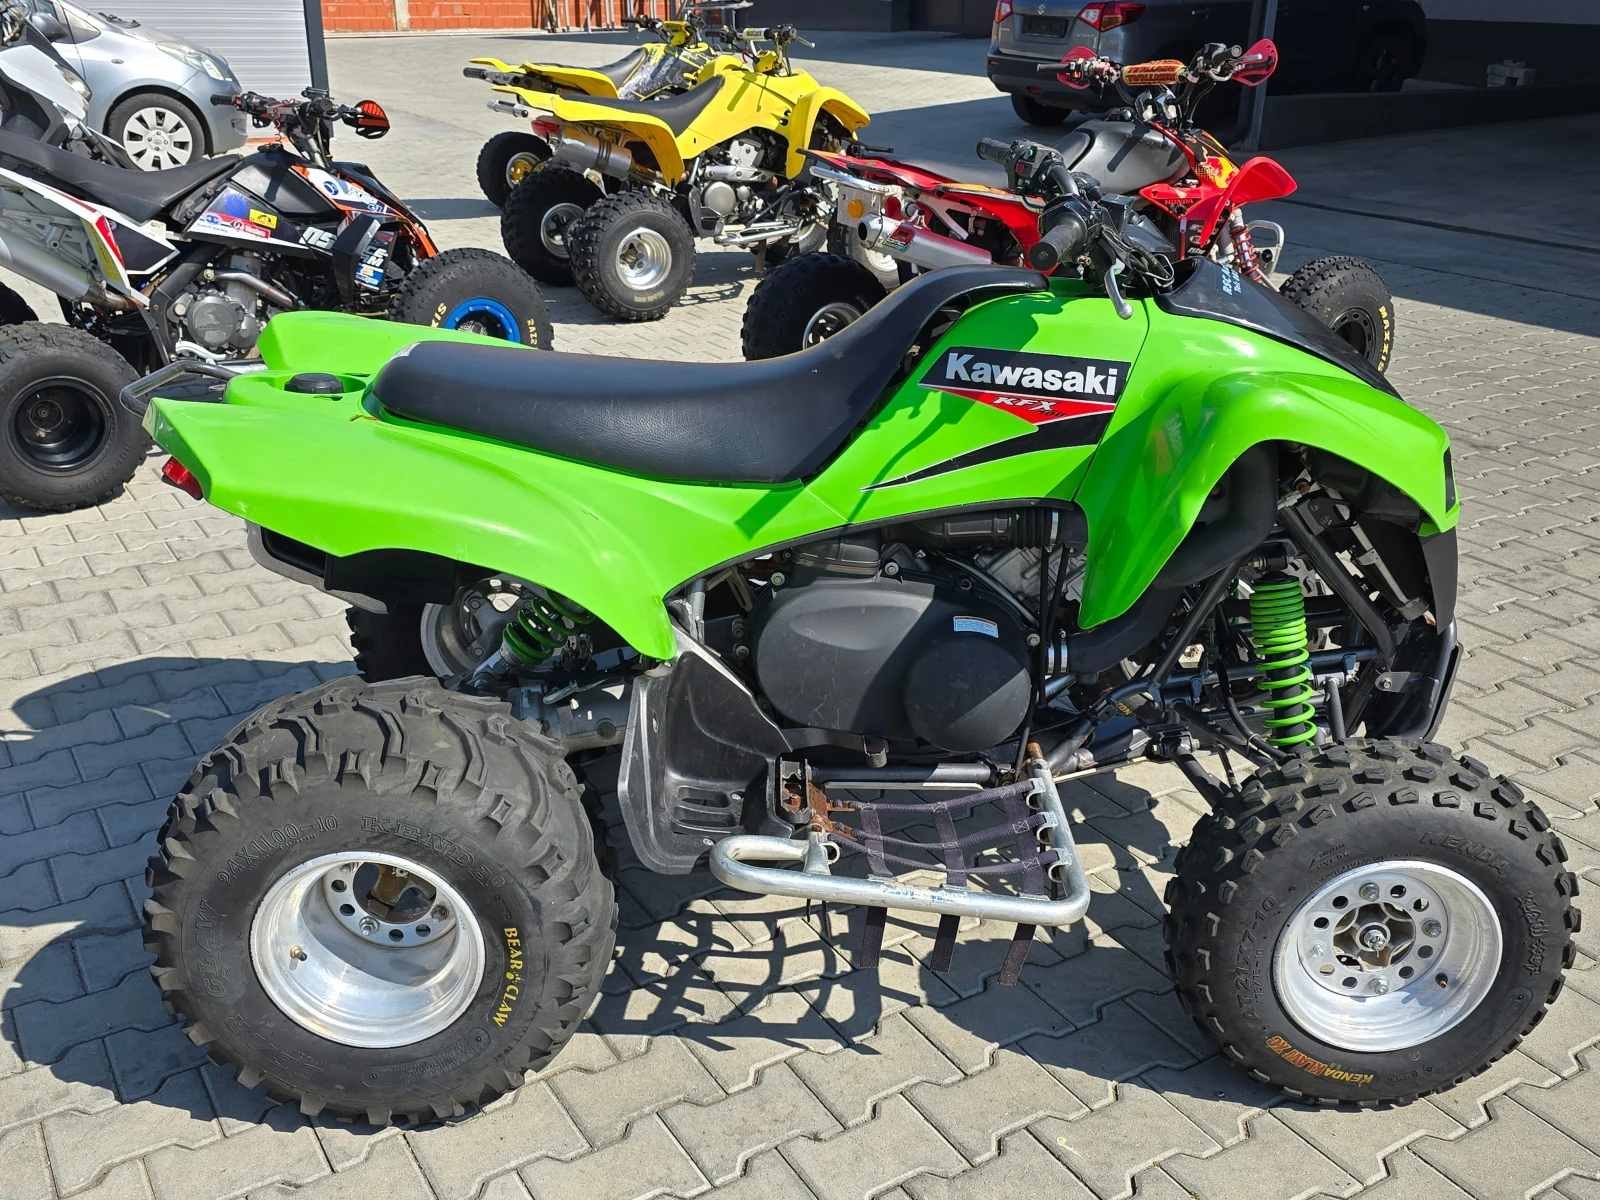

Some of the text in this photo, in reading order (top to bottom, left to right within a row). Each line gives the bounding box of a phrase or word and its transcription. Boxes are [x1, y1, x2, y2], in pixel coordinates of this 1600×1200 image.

[1222, 274, 1233, 296] RSC
[526, 318, 538, 346] RAZR
[1378, 305, 1391, 372] MAXXIS
[945, 352, 1118, 396] Kawasaki
[992, 396, 1060, 412] KFX
[360, 814, 491, 888] KENDA
[1420, 830, 1510, 875] KENDA
[195, 899, 226, 999] CLAW
[493, 926, 524, 1028] BEAR CLAW
[1283, 1049, 1327, 1076] KLAW
[1323, 1067, 1374, 1084] KENDA
